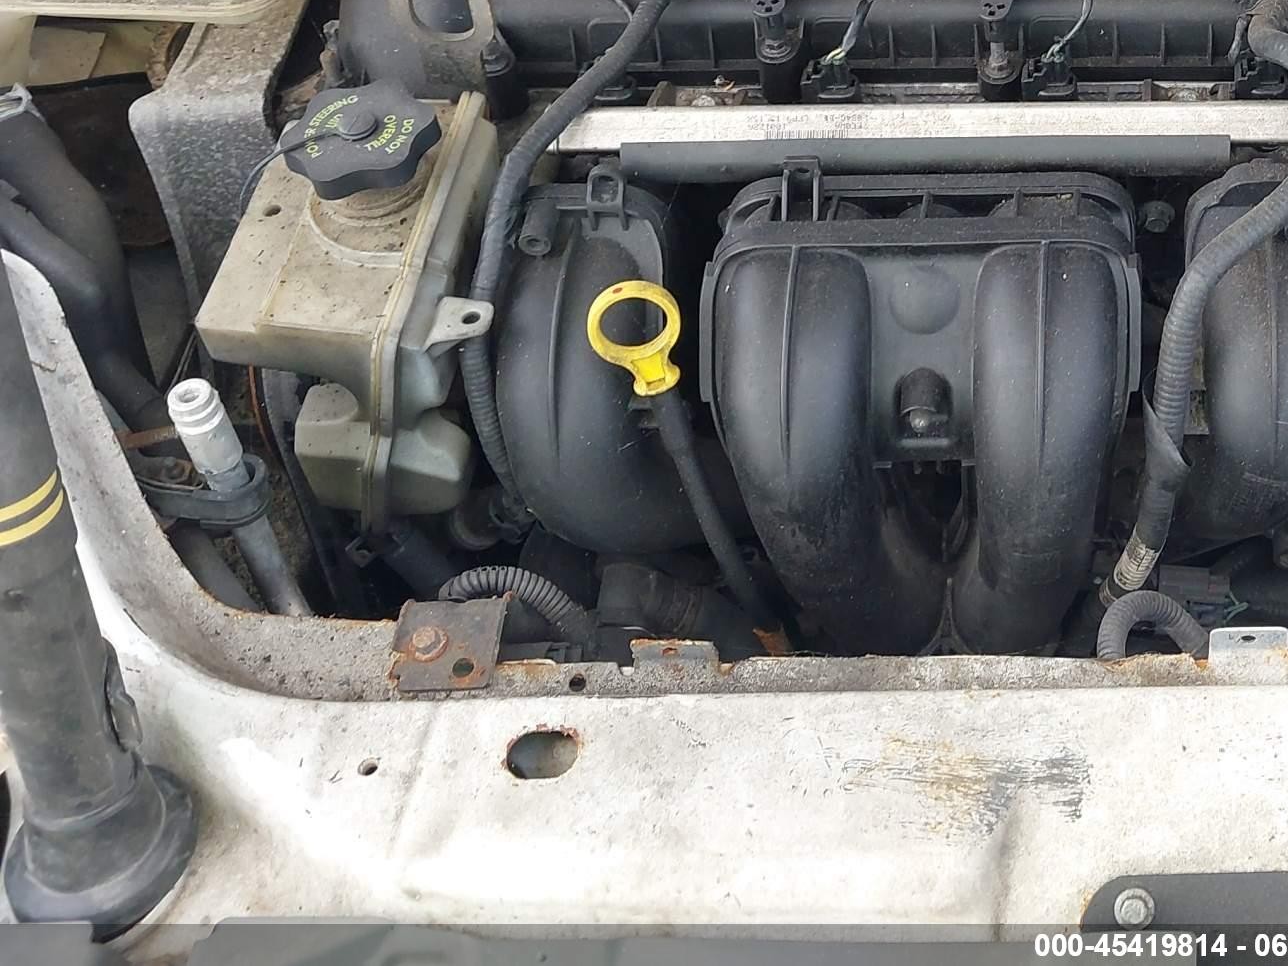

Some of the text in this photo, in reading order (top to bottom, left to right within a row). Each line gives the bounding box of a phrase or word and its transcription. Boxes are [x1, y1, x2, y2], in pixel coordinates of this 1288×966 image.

[303, 95, 359, 159] POER STEERING
[362, 114, 397, 152] OVERFILL
[384, 118, 415, 155] DO NOT
